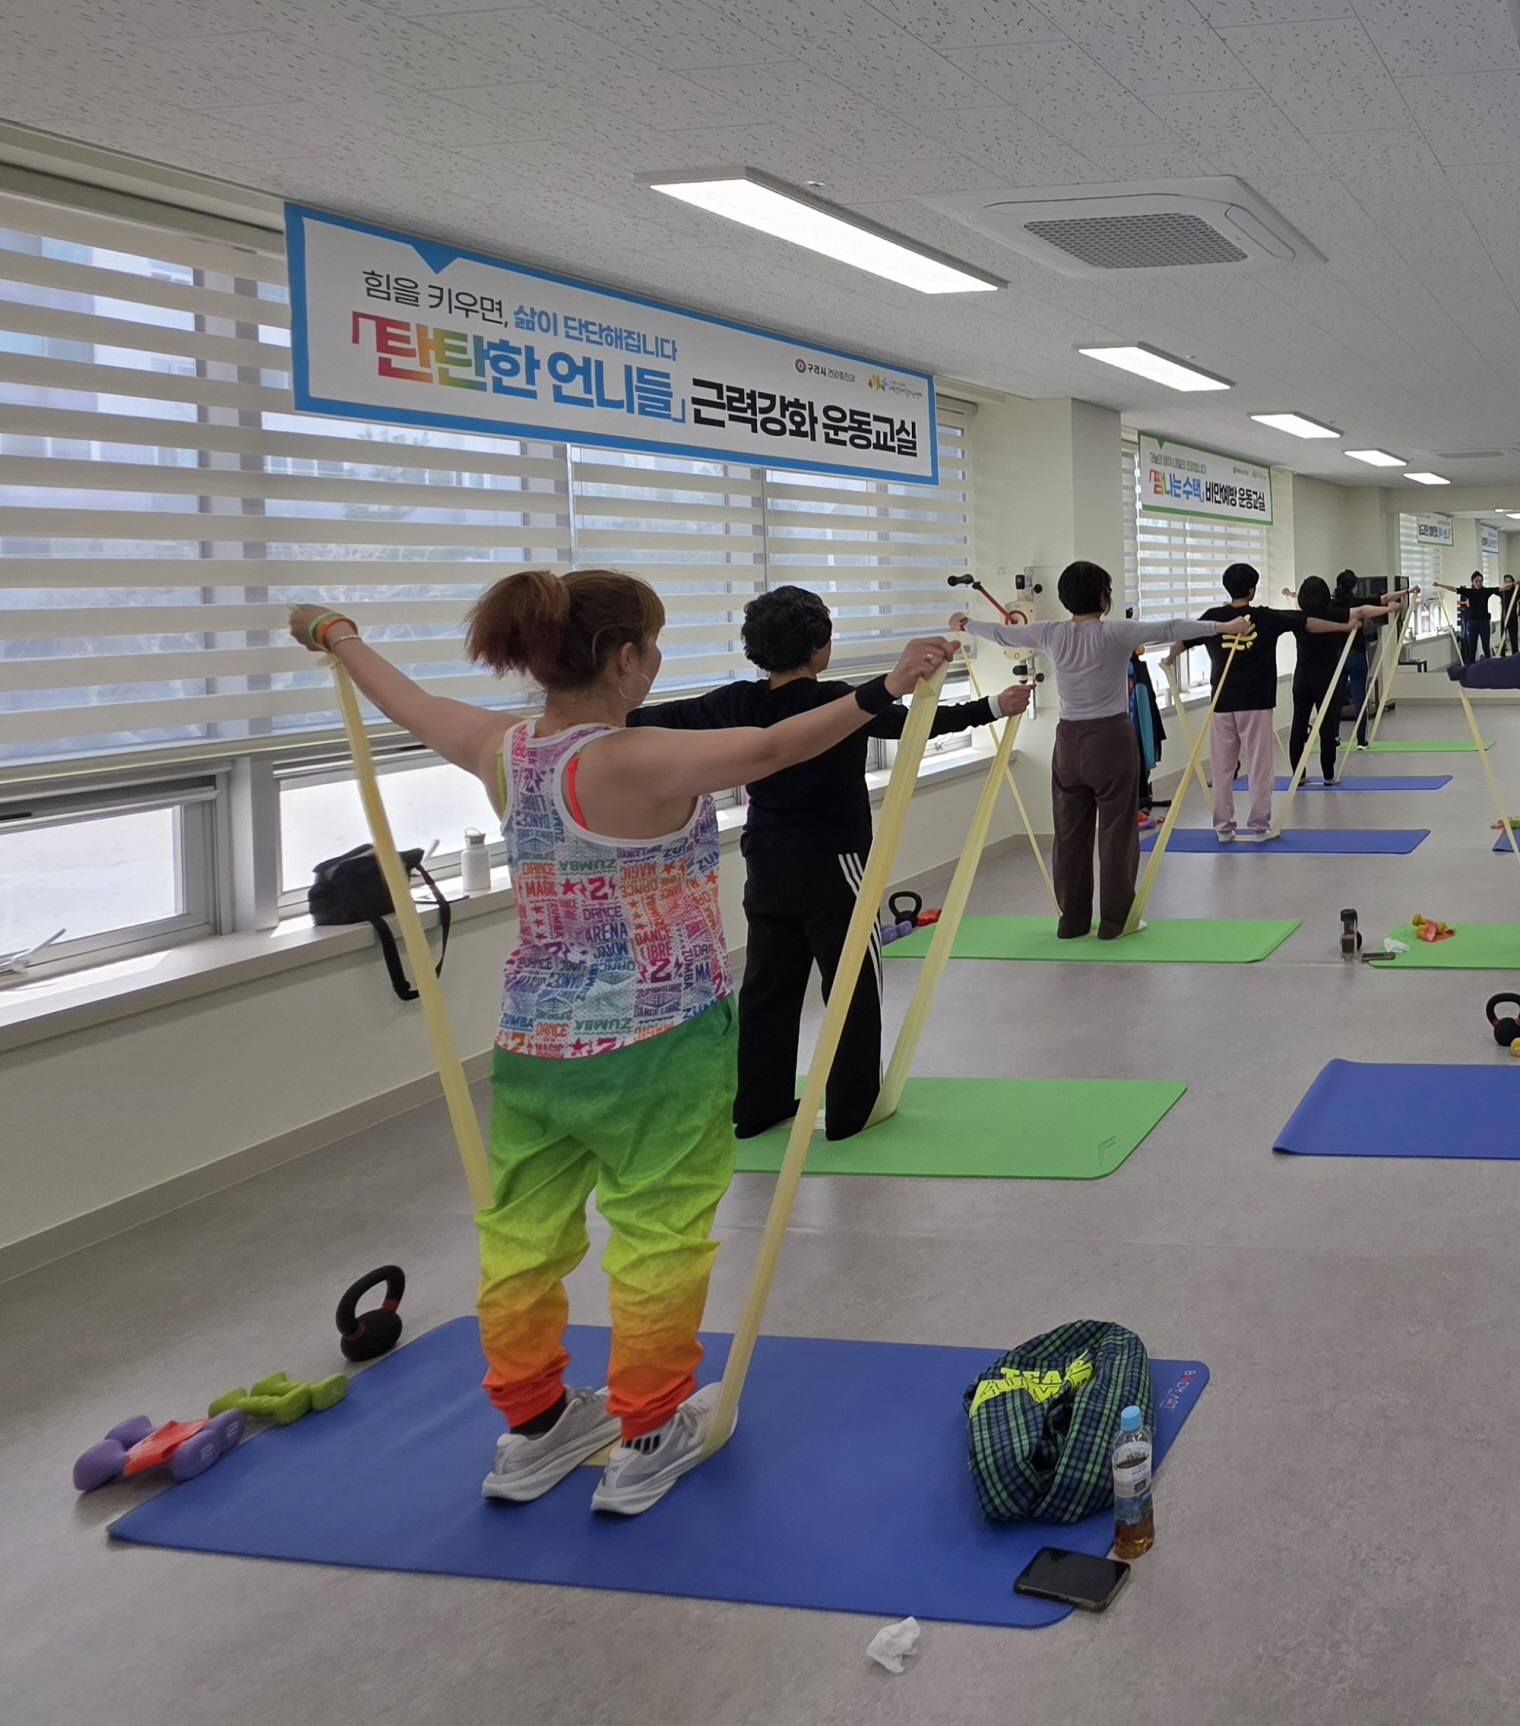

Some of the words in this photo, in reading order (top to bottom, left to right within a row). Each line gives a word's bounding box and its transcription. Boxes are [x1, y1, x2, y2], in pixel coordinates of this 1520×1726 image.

[363, 270, 420, 307] 힘을
[428, 284, 509, 329] 키우면,
[513, 304, 558, 337] 삶이
[563, 314, 678, 362] 단단해집니다
[807, 363, 827, 377] 구리시
[352, 310, 541, 400] 「탄탄한
[547, 351, 686, 424] 언니들」
[691, 377, 818, 442] 근력강화
[822, 404, 918, 458] 운동교실
[1205, 480, 1237, 507] 비만예방
[1238, 487, 1266, 512] 운동교실
[559, 860, 618, 871] ZUMBA
[620, 862, 657, 881] MAGIC
[582, 905, 623, 921] DANCE
[585, 922, 629, 942] ARENA
[634, 925, 672, 946] DANCE
[682, 949, 694, 990] ZUMBA
[500, 1013, 533, 1029] ZUMBA
[574, 1017, 633, 1032] ZUMBA
